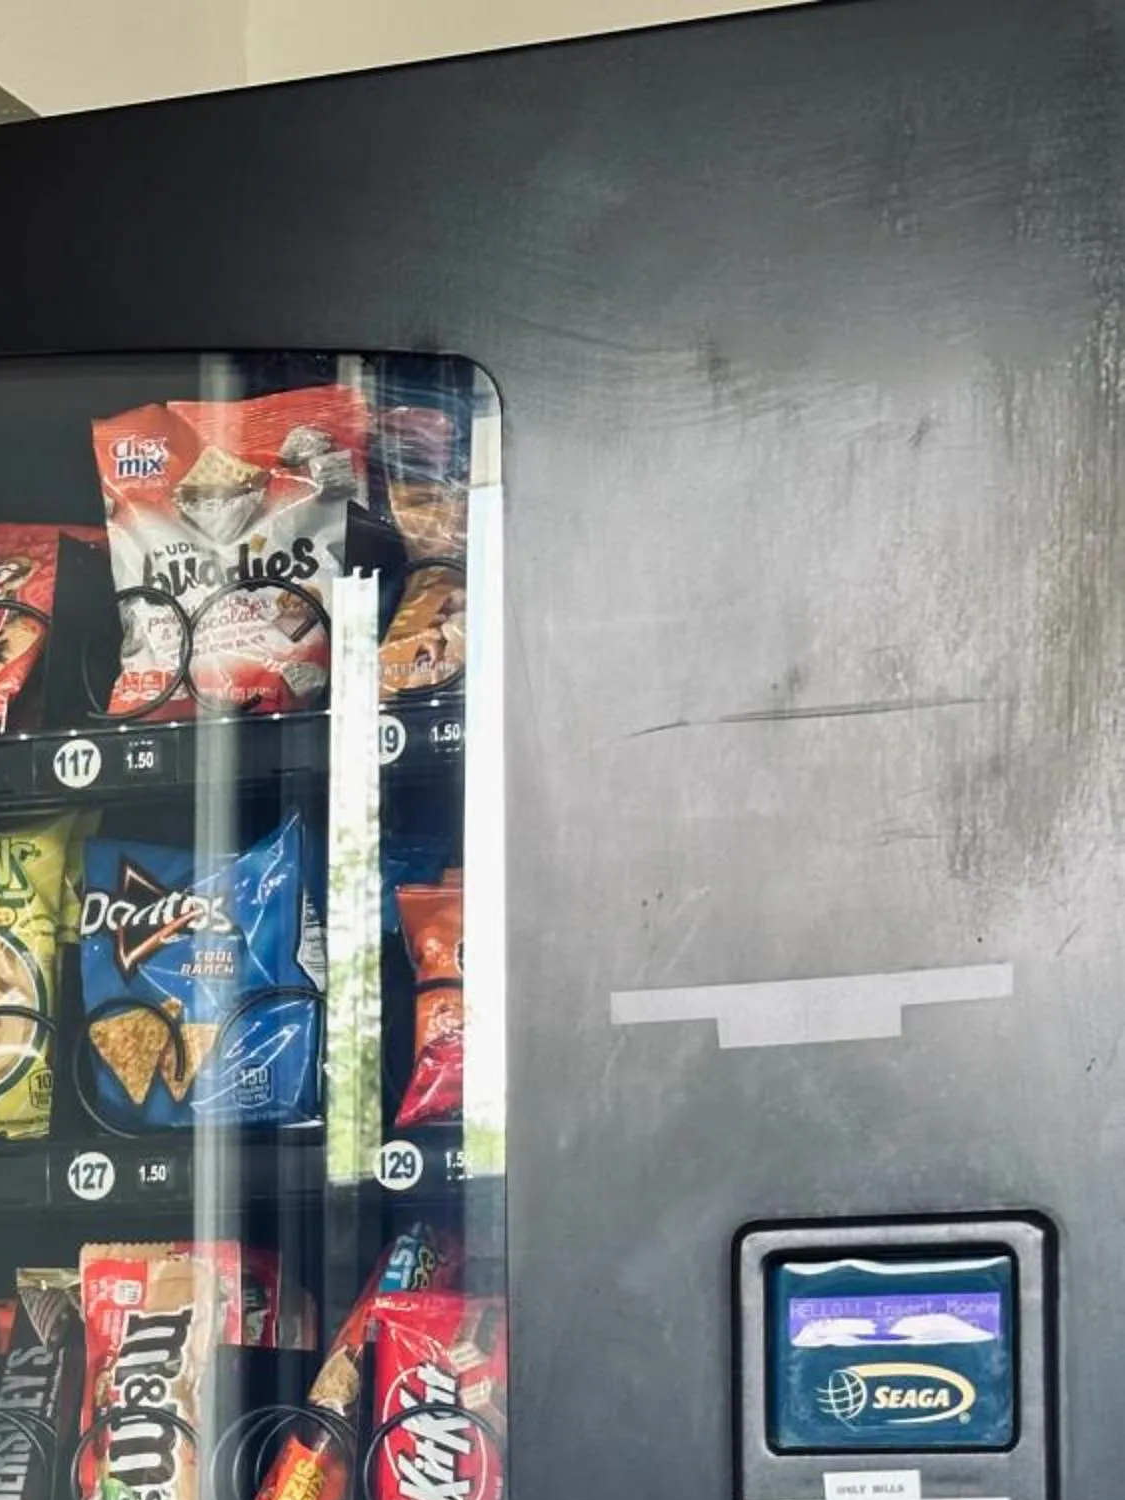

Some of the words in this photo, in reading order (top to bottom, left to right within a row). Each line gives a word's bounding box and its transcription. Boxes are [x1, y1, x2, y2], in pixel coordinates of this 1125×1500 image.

[116, 458, 165, 478] mix
[431, 724, 461, 742] 1.50
[54, 749, 95, 776] 117
[126, 751, 154, 769] 1.50
[80, 892, 233, 936] Doritos
[71, 1163, 108, 1188] 127
[139, 1165, 166, 1182] 1.50
[380, 1151, 416, 1178] 129
[872, 1385, 950, 1409] SEAGA
